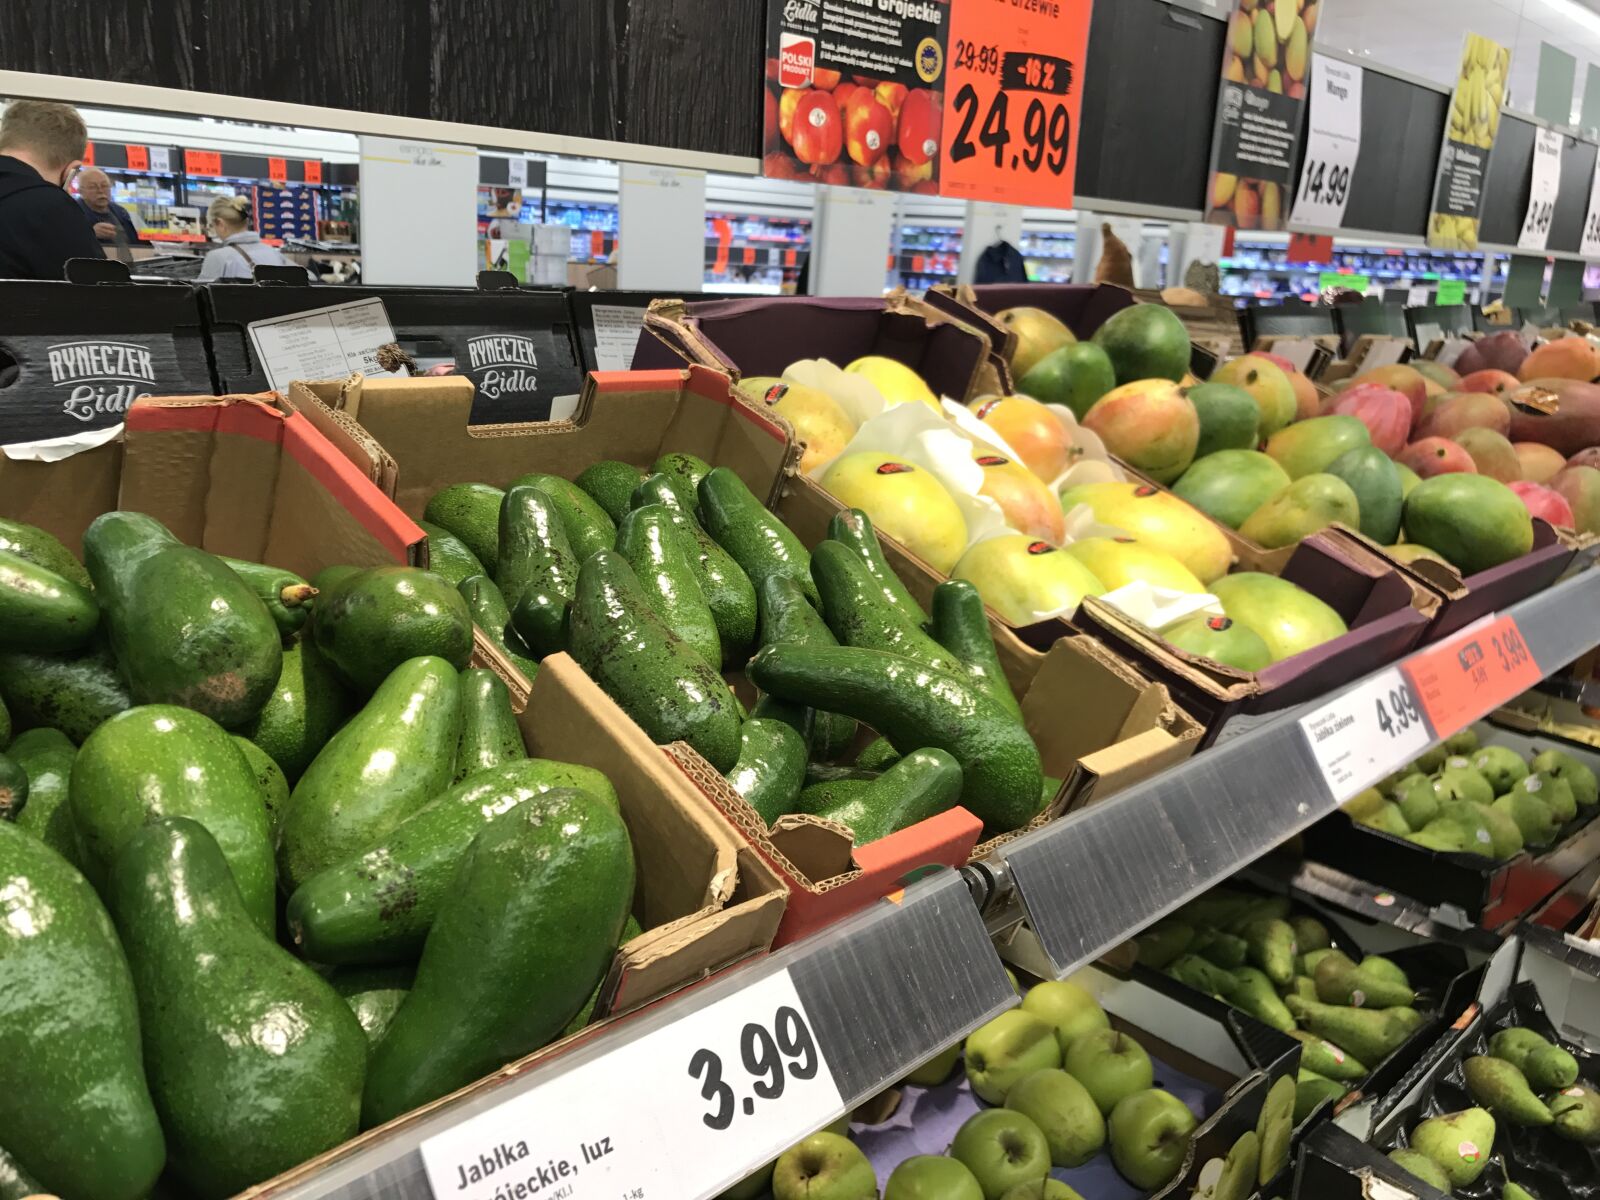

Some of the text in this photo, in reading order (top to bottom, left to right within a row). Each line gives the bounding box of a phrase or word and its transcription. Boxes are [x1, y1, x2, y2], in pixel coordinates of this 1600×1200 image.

[783, 0, 817, 22] Lidla
[782, 51, 812, 67] POLSKI
[782, 65, 810, 76] PRODUKT
[954, 39, 998, 75] 29.99
[951, 83, 1069, 175] 24.99
[1303, 160, 1349, 206] 14.99
[48, 345, 155, 382] RYNECZEK
[468, 337, 538, 368] RYNECZEK
[480, 369, 538, 399] Lidla
[63, 385, 152, 421] Lidl
[1376, 684, 1419, 738] 4.99
[688, 1006, 818, 1130] 3.99
[457, 1140, 530, 1190] Jabłka
[580, 1136, 614, 1164] luz
